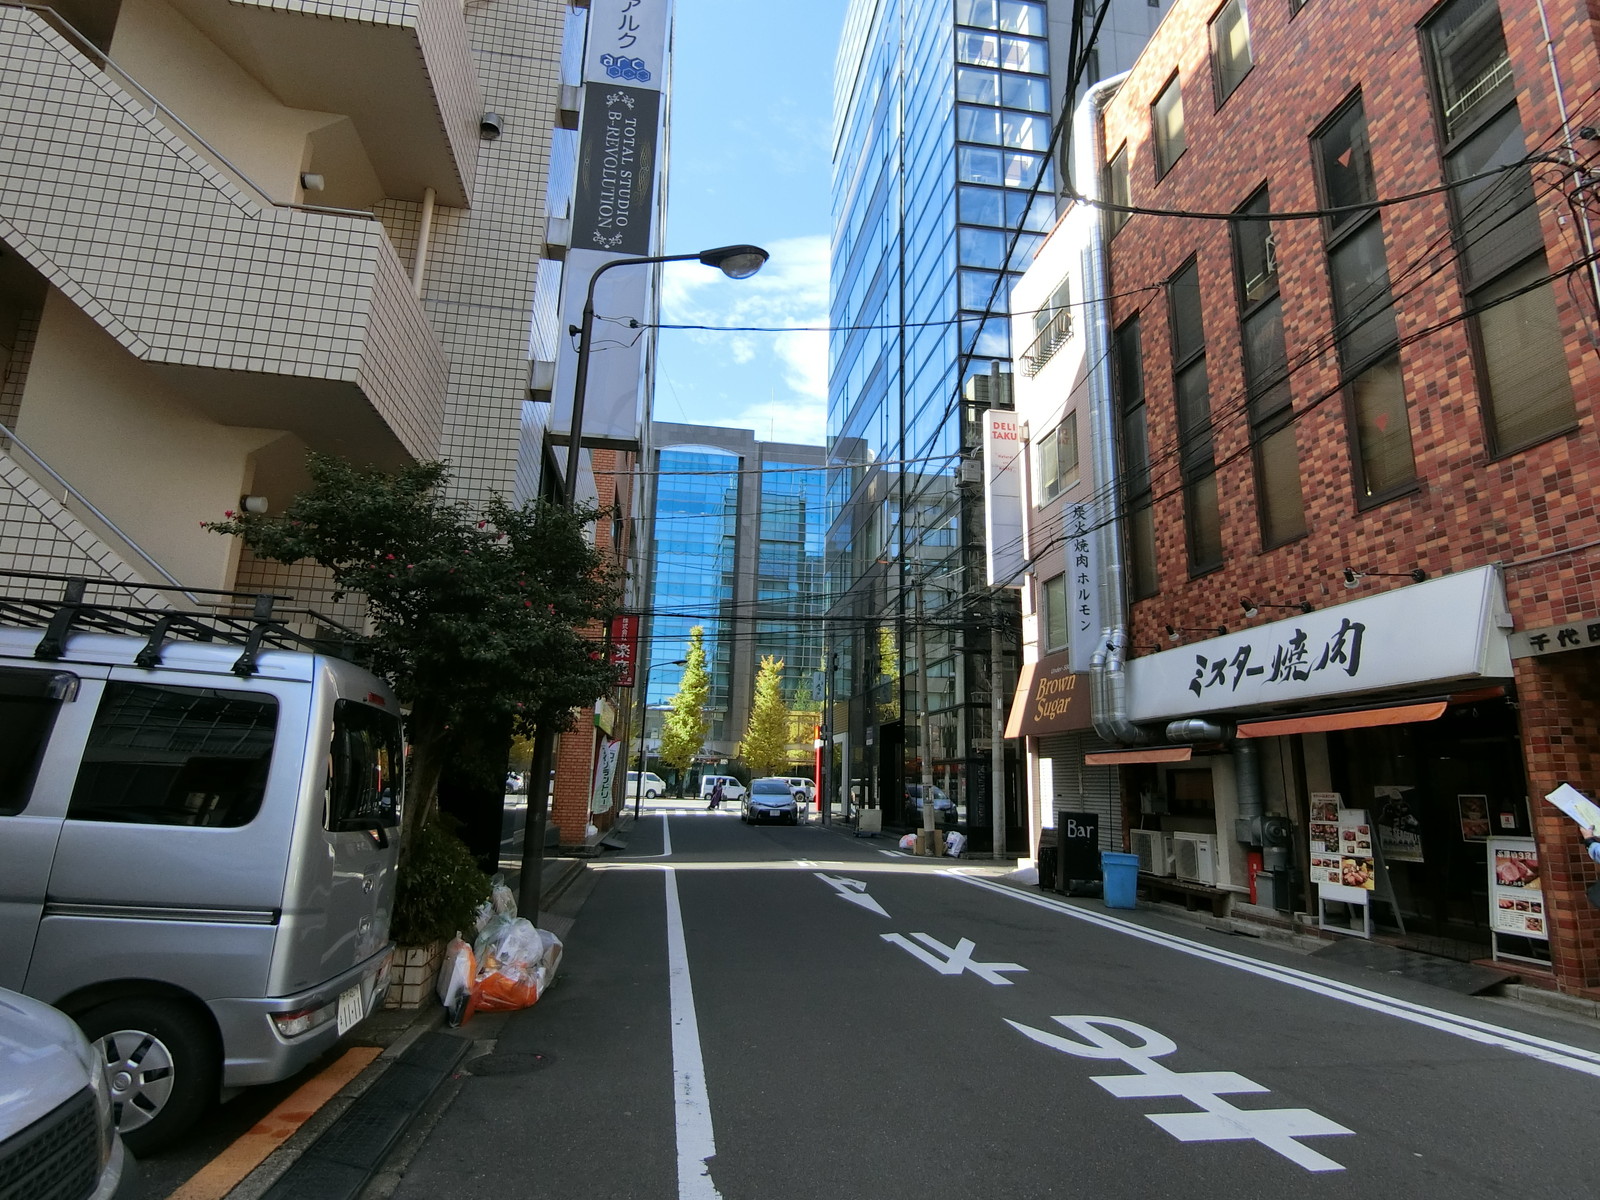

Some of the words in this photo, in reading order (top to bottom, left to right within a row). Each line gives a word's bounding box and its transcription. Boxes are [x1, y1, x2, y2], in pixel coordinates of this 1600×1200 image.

[621, 118, 637, 165] TOTAL
[598, 110, 622, 228] B-REVOLUTION
[615, 170, 632, 227] STUDIO
[992, 431, 1017, 441] TAKU
[993, 421, 1016, 431] DELI
[1073, 506, 1091, 631] 炭火焼肉ホルモン
[1189, 617, 1366, 698] ミスター焼肉
[1035, 674, 1076, 701] Brown
[1034, 697, 1072, 722] Sugar
[1067, 818, 1094, 838] Bar
